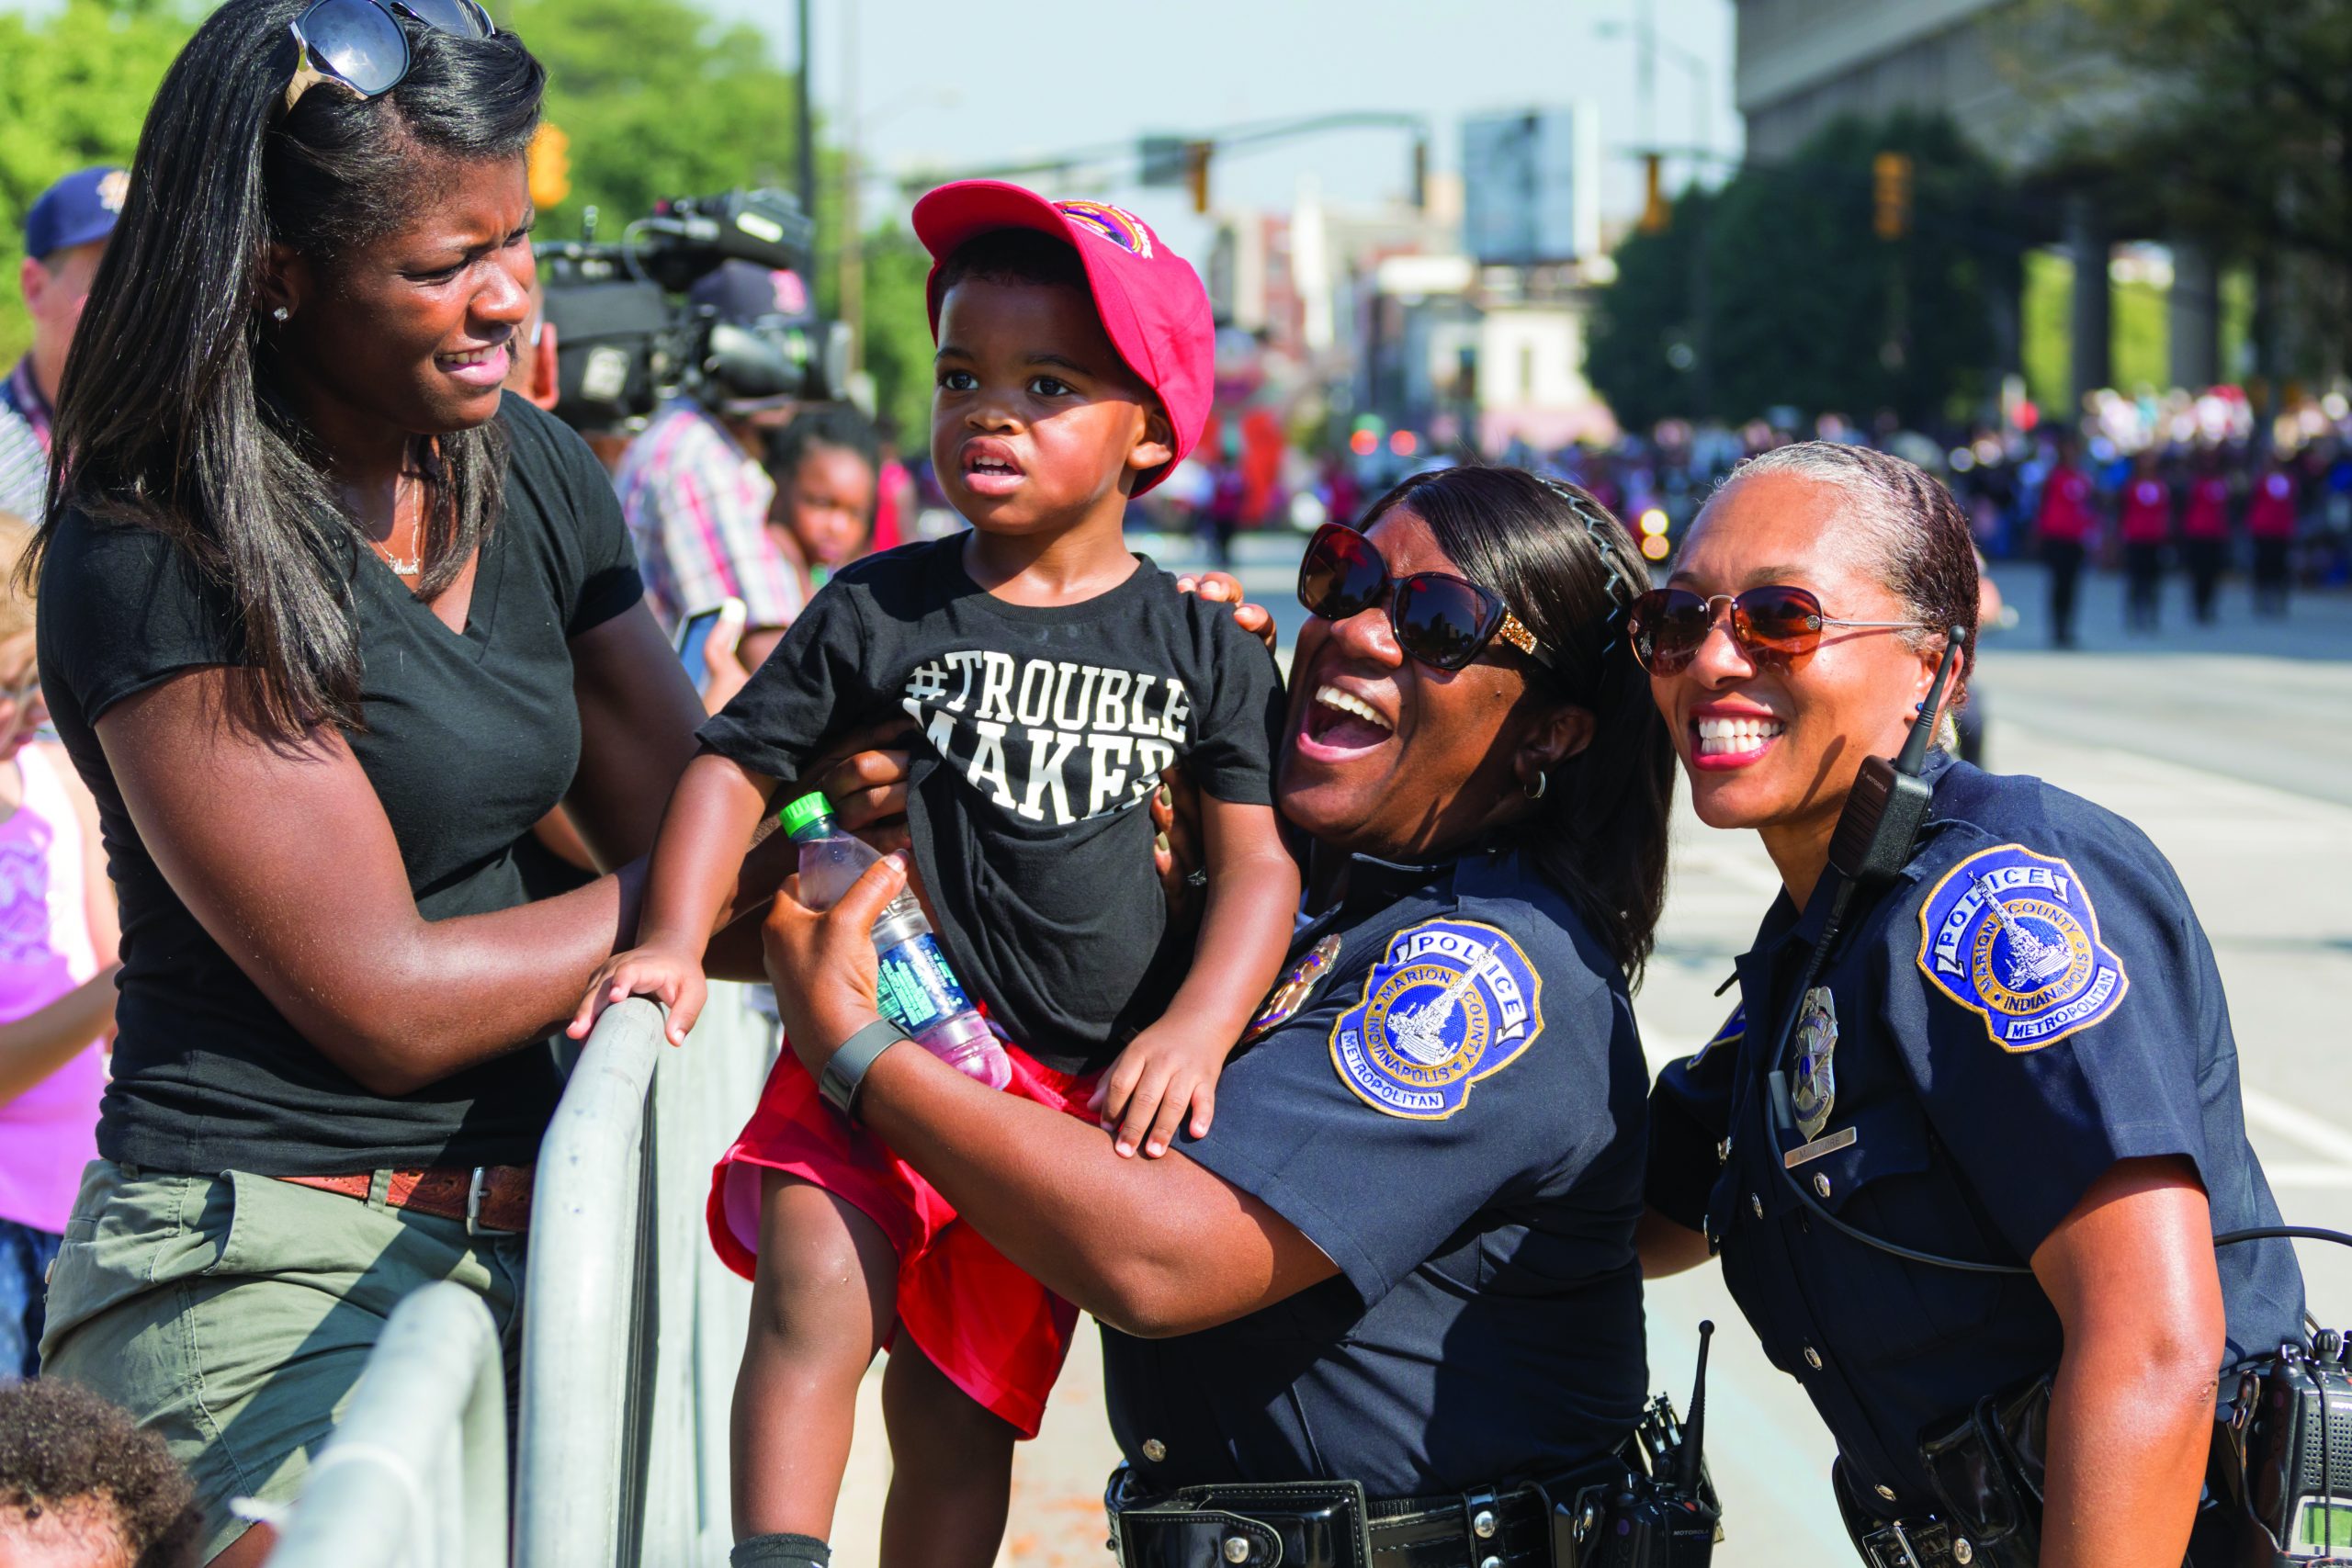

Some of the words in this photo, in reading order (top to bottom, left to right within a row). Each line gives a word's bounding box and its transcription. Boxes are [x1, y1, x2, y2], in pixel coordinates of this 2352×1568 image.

[905, 650, 1191, 743] #TROUBLE
[1939, 869, 2044, 948] POLICE
[1975, 921, 1997, 994] MARION
[2007, 901, 2078, 933] COUNTY
[1419, 936, 1521, 1016] POLICE
[2003, 953, 2089, 1011] INDIANAPOLIS
[2012, 973, 2113, 1038] METROPOLITAN
[1366, 1015, 1451, 1082] INDIANAPOLIS
[1381, 968, 1453, 1000] MARION
[1464, 990, 1485, 1064] COUNTY
[1343, 1033, 1440, 1107] METROPOLITAN
